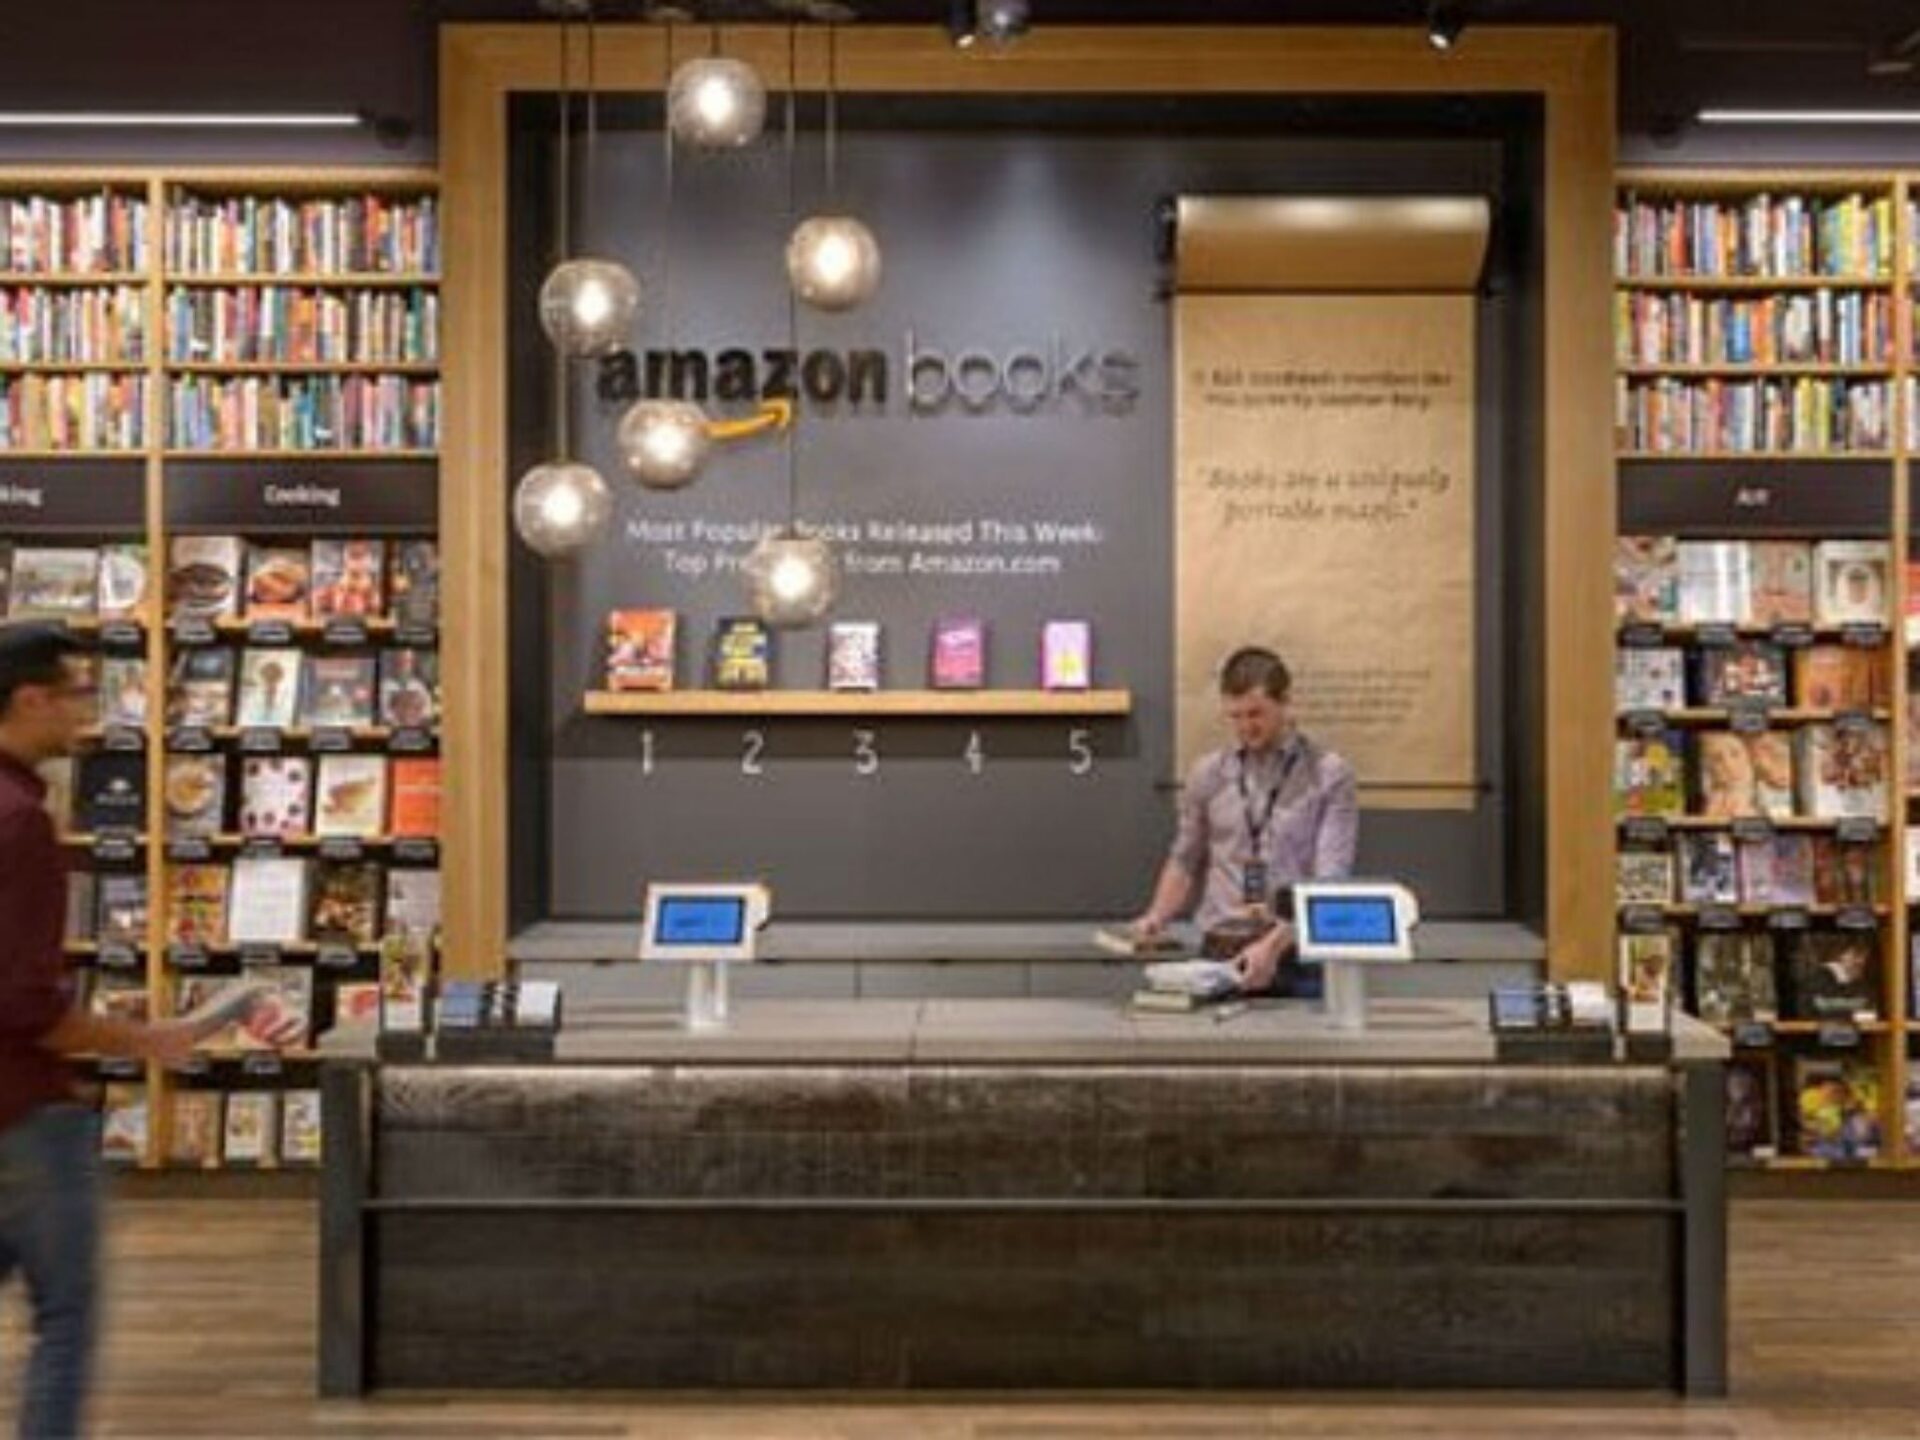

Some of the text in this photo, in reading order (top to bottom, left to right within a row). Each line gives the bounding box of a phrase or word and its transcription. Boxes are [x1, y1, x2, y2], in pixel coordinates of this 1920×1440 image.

[596, 328, 1141, 417] amazon books
[263, 483, 342, 507] Cooking
[867, 520, 973, 543] Released
[979, 520, 1028, 542] This
[664, 551, 708, 575] Top
[908, 552, 1061, 574] Amazon.com
[642, 729, 1092, 775] 1 2 3 4 5
